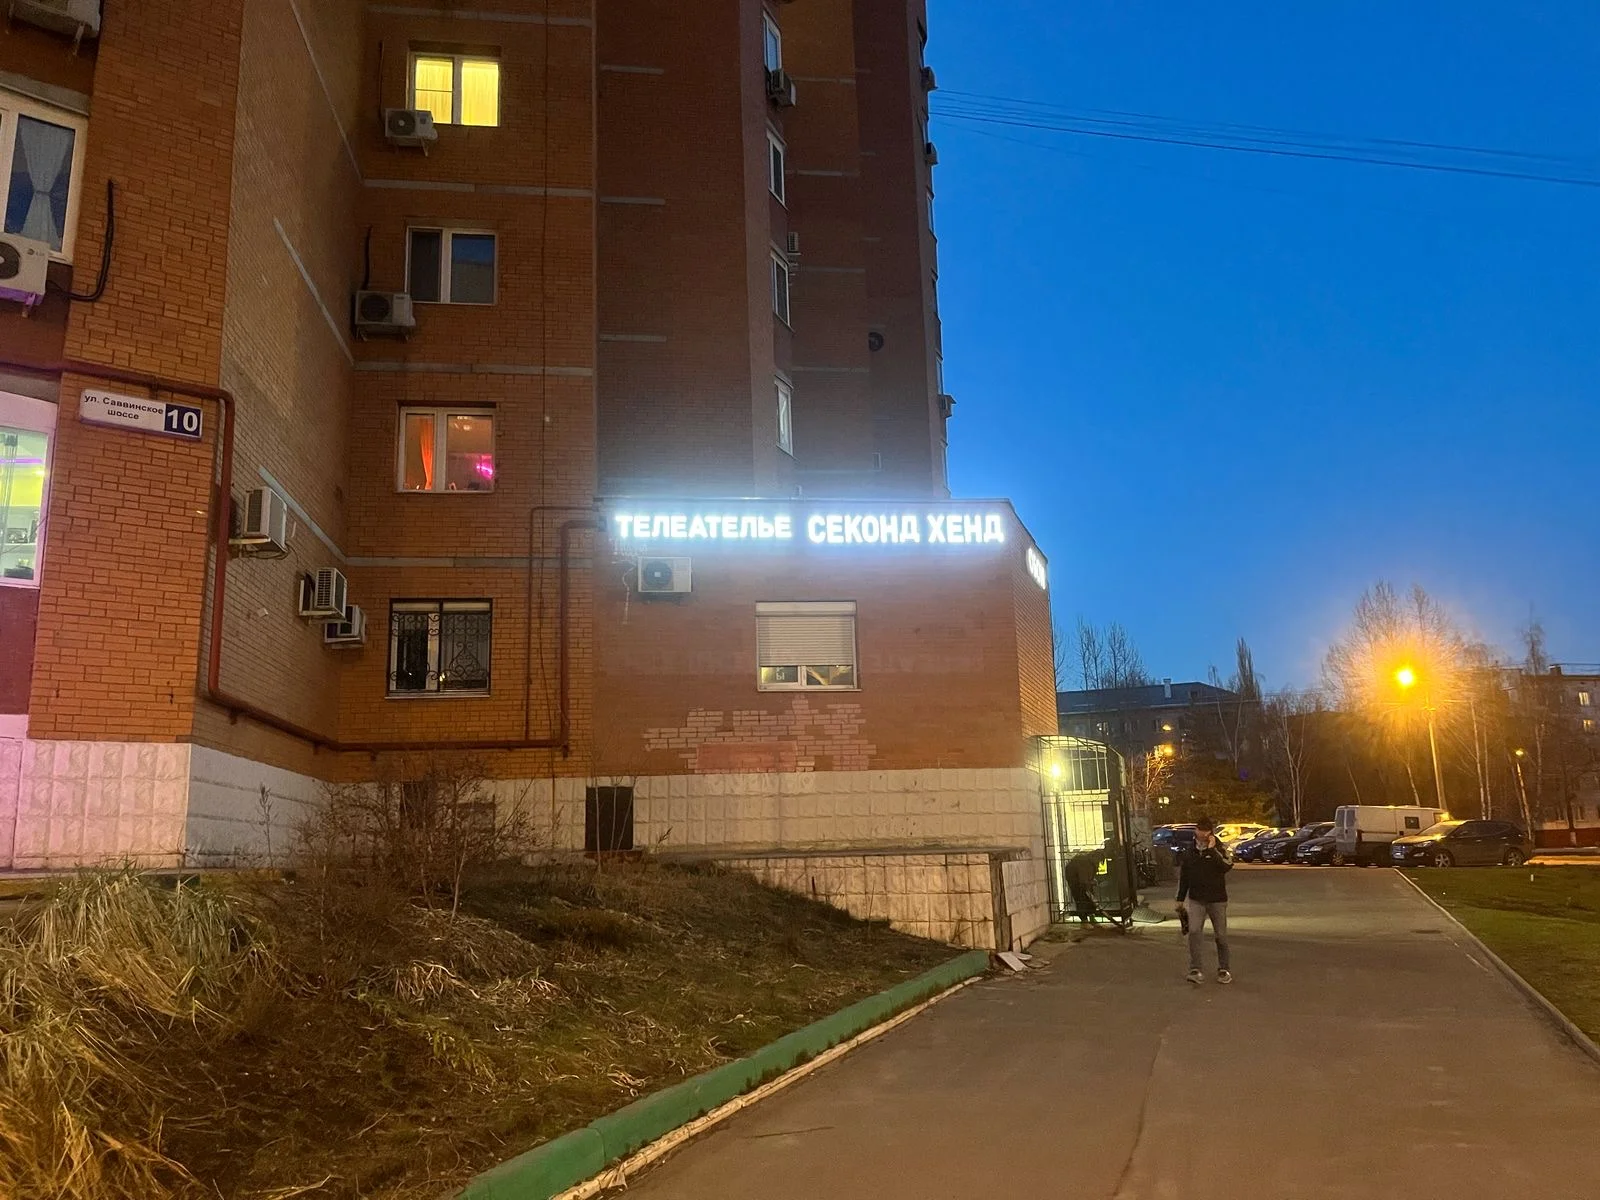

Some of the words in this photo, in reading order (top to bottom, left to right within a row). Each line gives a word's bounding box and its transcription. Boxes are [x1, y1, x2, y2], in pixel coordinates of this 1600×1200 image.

[84, 394, 100, 404] ул.
[102, 397, 164, 415] Саввинское
[107, 408, 140, 420] шоссе
[167, 409, 199, 433] 10
[614, 514, 793, 538] ТЕЛЕАТЕЛЬЕ
[807, 514, 921, 544] СЕКОНД
[926, 514, 1004, 544] ХЕНД
